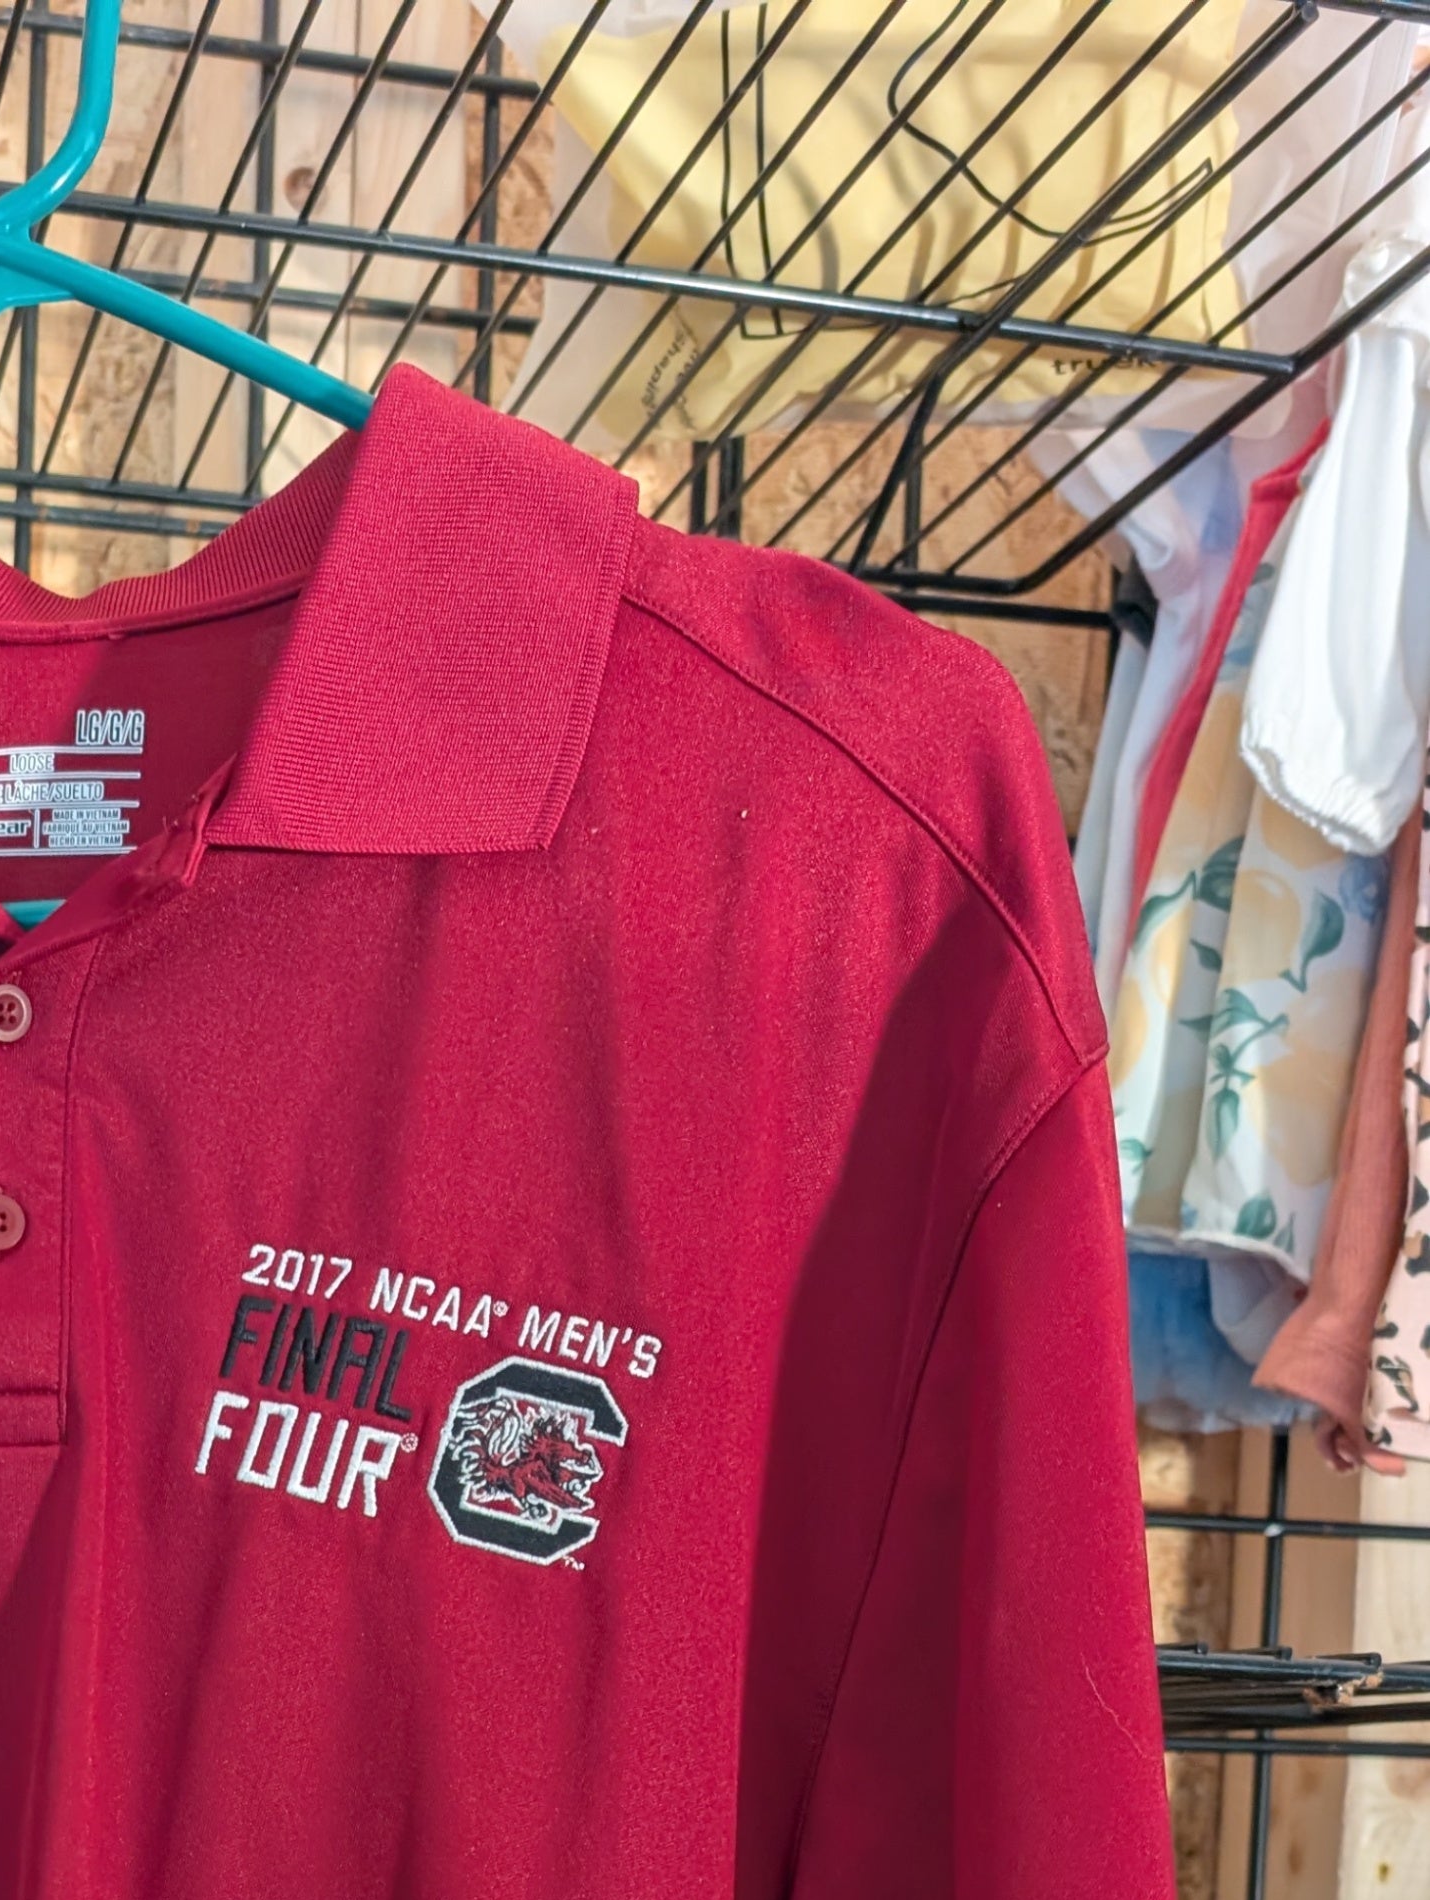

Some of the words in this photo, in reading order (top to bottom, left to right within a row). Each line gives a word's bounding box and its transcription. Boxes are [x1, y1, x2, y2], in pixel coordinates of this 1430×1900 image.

[77, 710, 144, 745] LG/G/G
[10, 753, 55, 773] LOOSE
[53, 809, 74, 820] MADE
[86, 809, 120, 820] VIETNAM
[95, 821, 128, 832] VIETNAM
[89, 835, 121, 846] VIETNAM
[241, 1243, 352, 1298] 2017
[517, 1304, 663, 1378] MEN'S
[219, 1294, 413, 1422] FINAL
